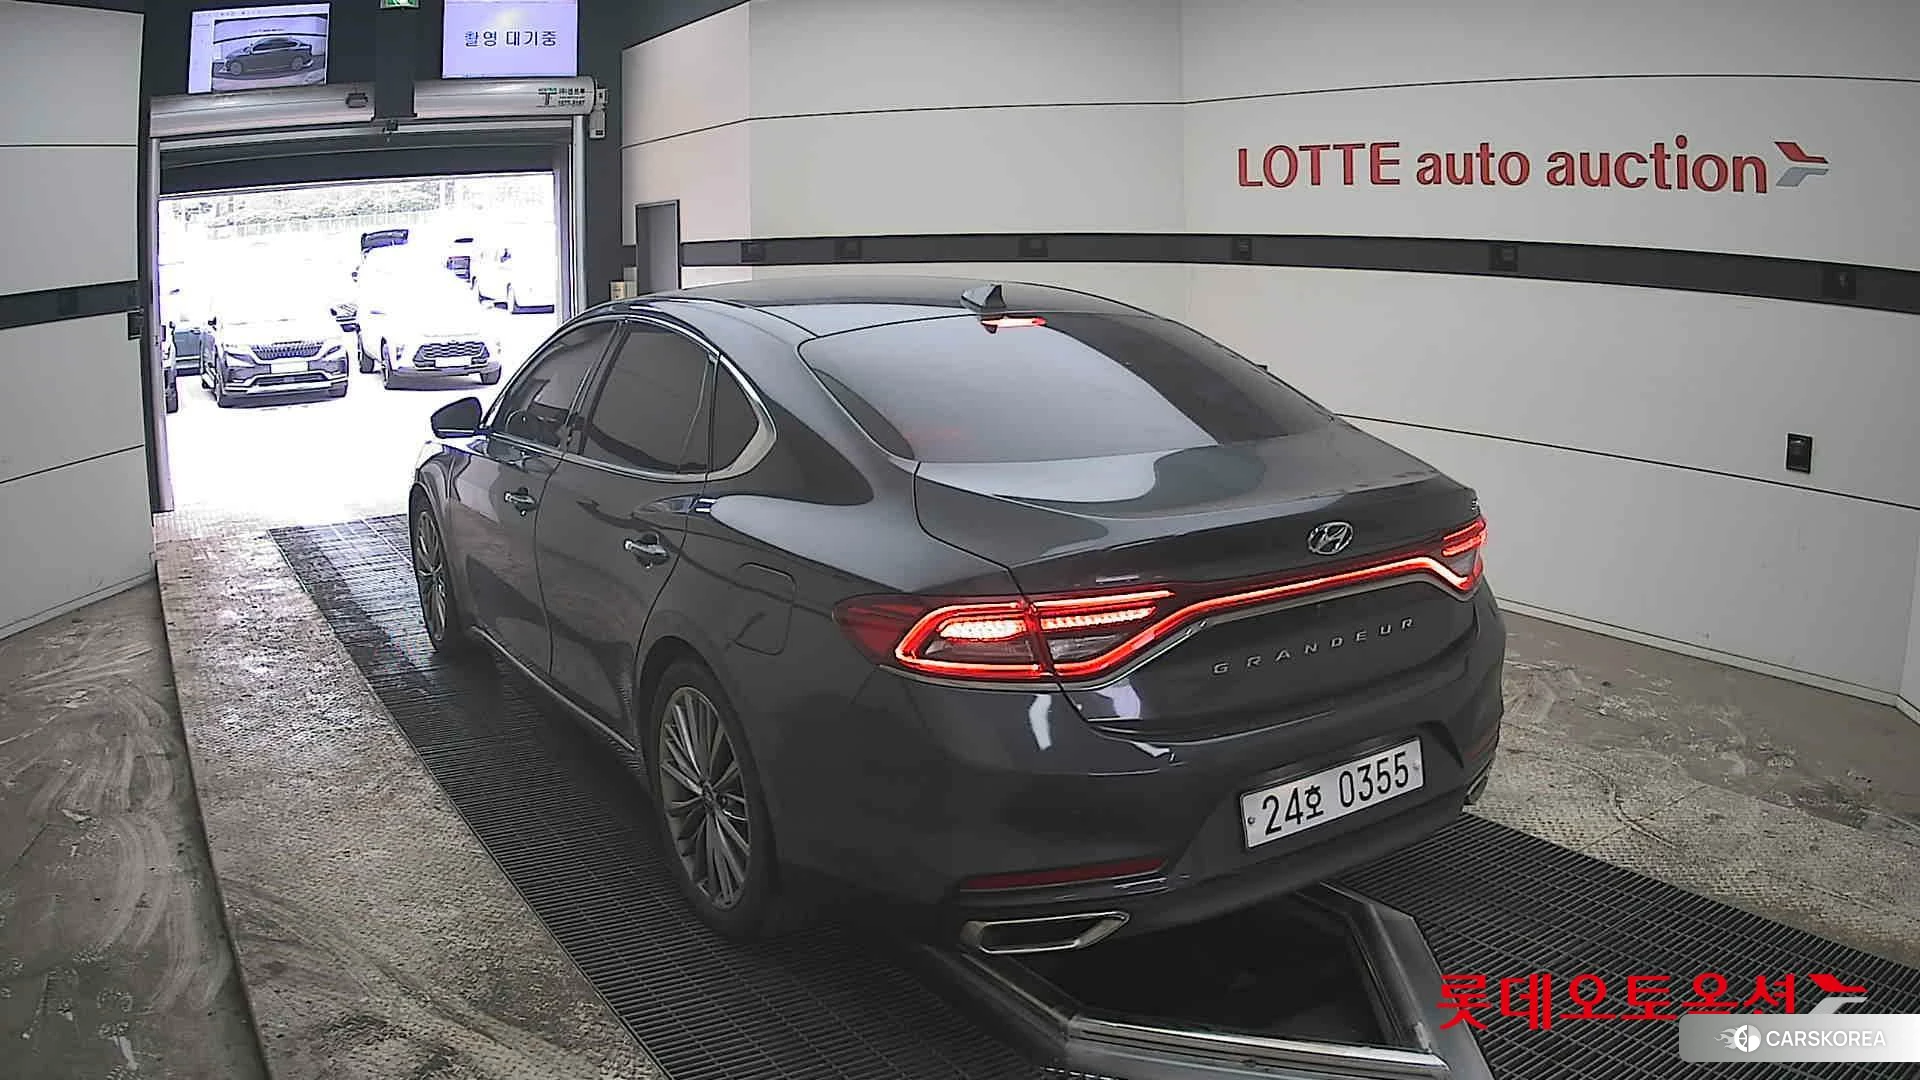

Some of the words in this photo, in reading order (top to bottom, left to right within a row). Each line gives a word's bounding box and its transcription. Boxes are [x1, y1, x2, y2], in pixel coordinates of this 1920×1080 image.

[506, 30, 557, 47] 대기중
[1238, 142, 1400, 187] LOTTE
[1416, 142, 1530, 186] auto
[1546, 136, 1767, 194] auction
[1213, 617, 1414, 674] GRANDEUR
[1261, 785, 1323, 836] 24호
[1339, 752, 1409, 807] 0355
